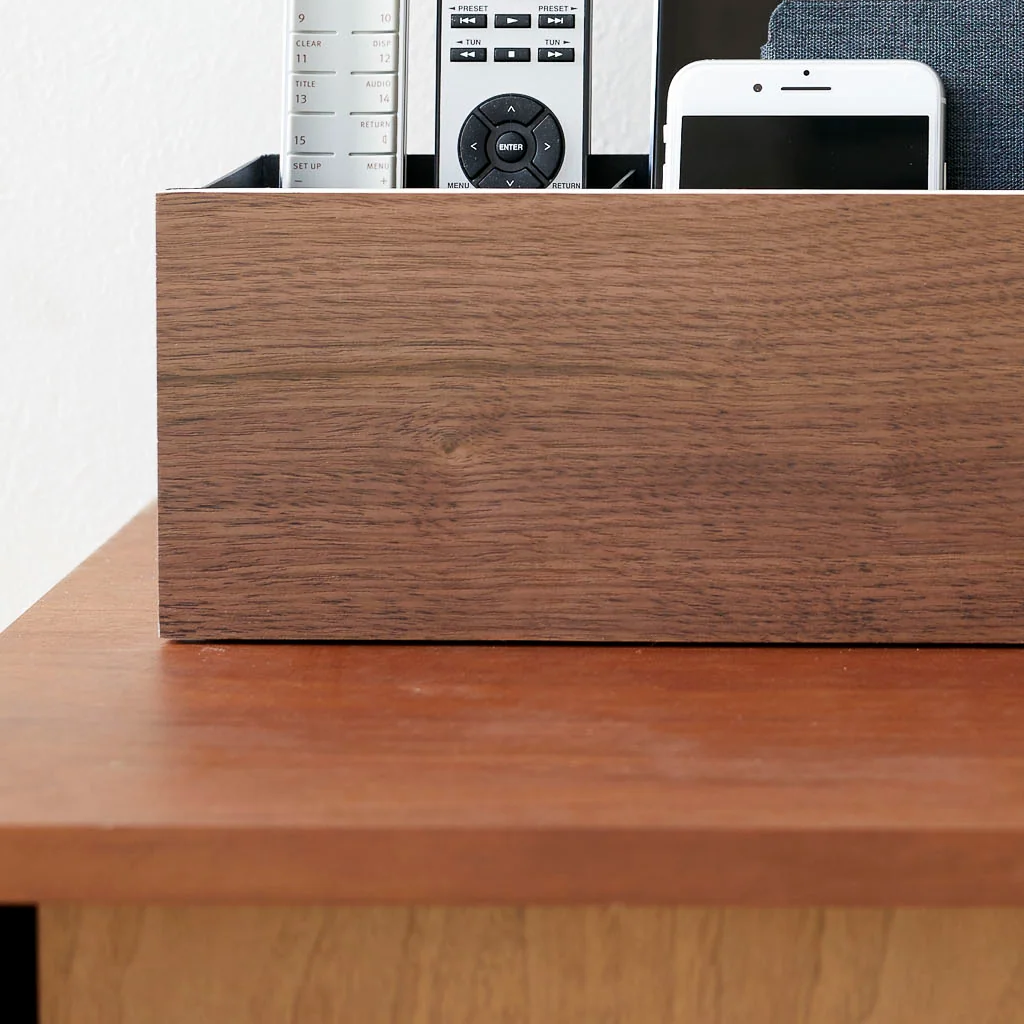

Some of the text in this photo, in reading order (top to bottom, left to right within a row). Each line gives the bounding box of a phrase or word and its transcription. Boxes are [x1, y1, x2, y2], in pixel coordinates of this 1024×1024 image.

[298, 13, 305, 23] 9
[380, 13, 392, 23] 10
[372, 40, 391, 48] DISP
[296, 53, 307, 63] 11
[379, 53, 391, 63] 12
[295, 80, 315, 88] TITLE
[366, 80, 391, 88] AUDIO
[295, 94, 307, 104] 13
[379, 94, 390, 103] 14
[360, 120, 391, 128] RETURN
[294, 135, 306, 145] 15
[499, 143, 524, 151] ENTER
[292, 162, 322, 170] SET UP
[366, 162, 390, 170] MENU
